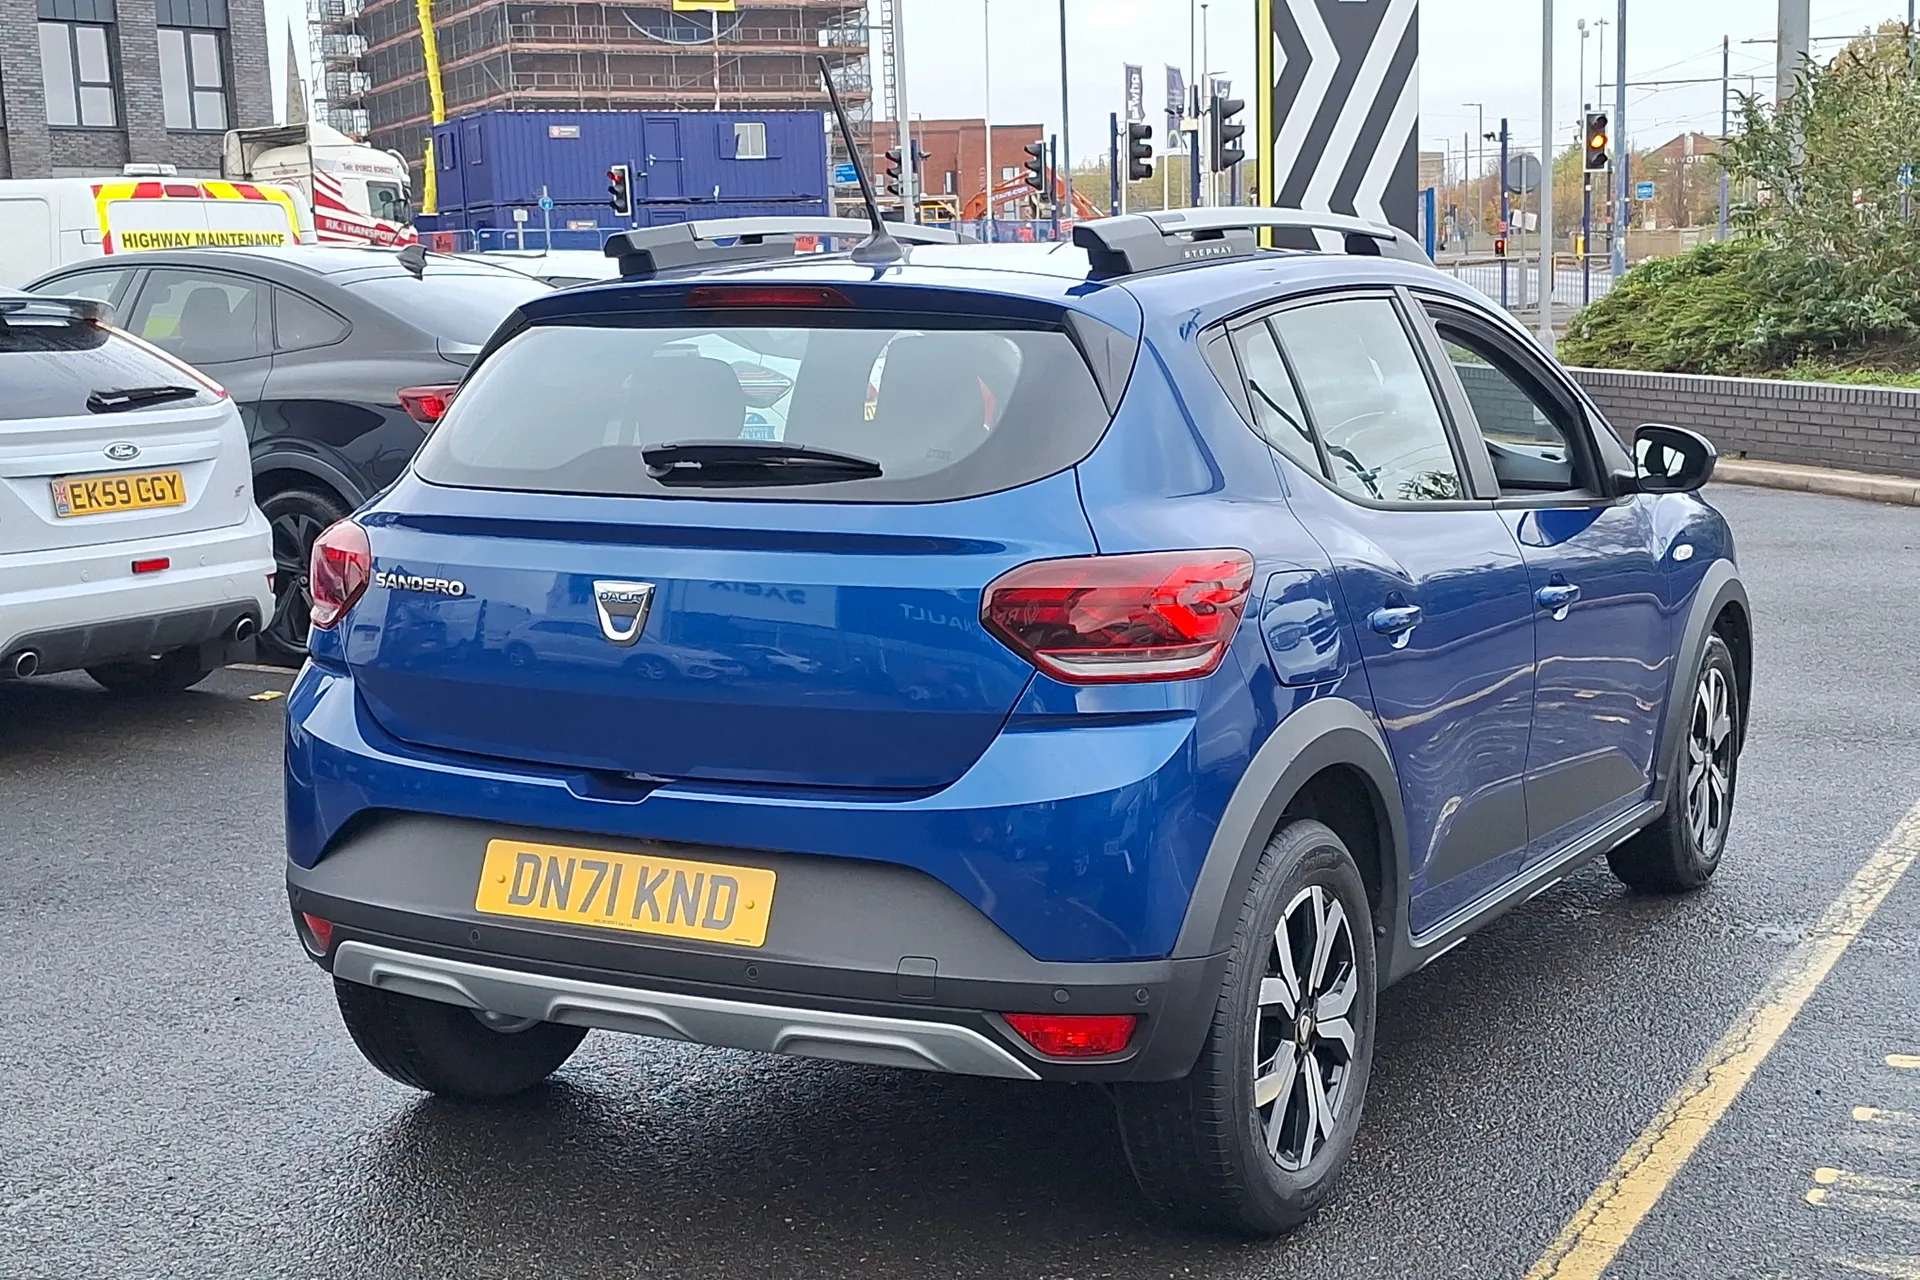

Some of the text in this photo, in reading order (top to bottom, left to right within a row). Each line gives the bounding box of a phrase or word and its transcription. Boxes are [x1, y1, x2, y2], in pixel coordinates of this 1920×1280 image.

[1664, 155, 1706, 165] NOVOTE
[122, 232, 285, 249] HIGHWAY MAINTENANCE
[1184, 245, 1231, 259] STEPWAY
[69, 474, 179, 510] EK59 CGY
[375, 572, 465, 597] SANDERO
[599, 591, 644, 604] DACIA
[508, 852, 739, 931] DN71 KND
